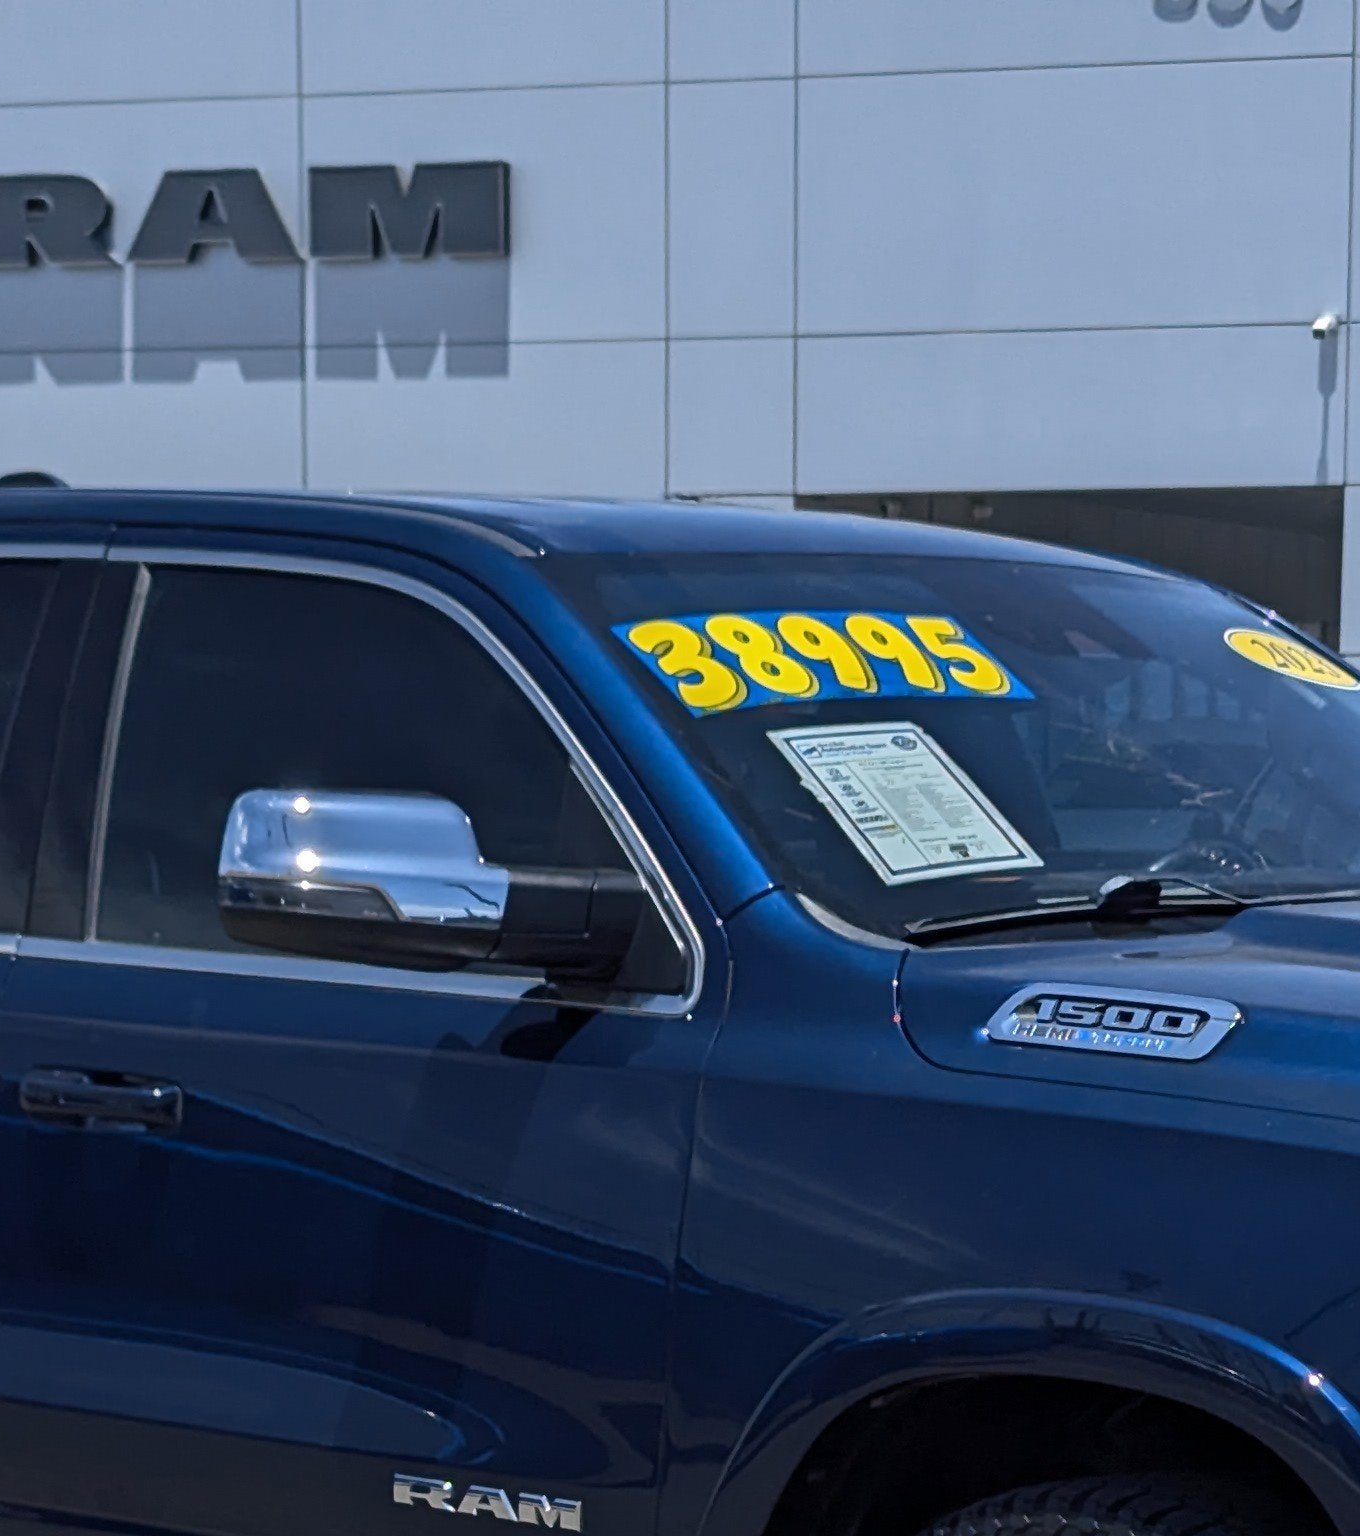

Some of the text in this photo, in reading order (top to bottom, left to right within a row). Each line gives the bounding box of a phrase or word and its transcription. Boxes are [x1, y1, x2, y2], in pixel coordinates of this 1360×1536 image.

[627, 612, 1011, 712] 38995
[1033, 998, 1200, 1037] 1500
[392, 1472, 583, 1533] RAM
